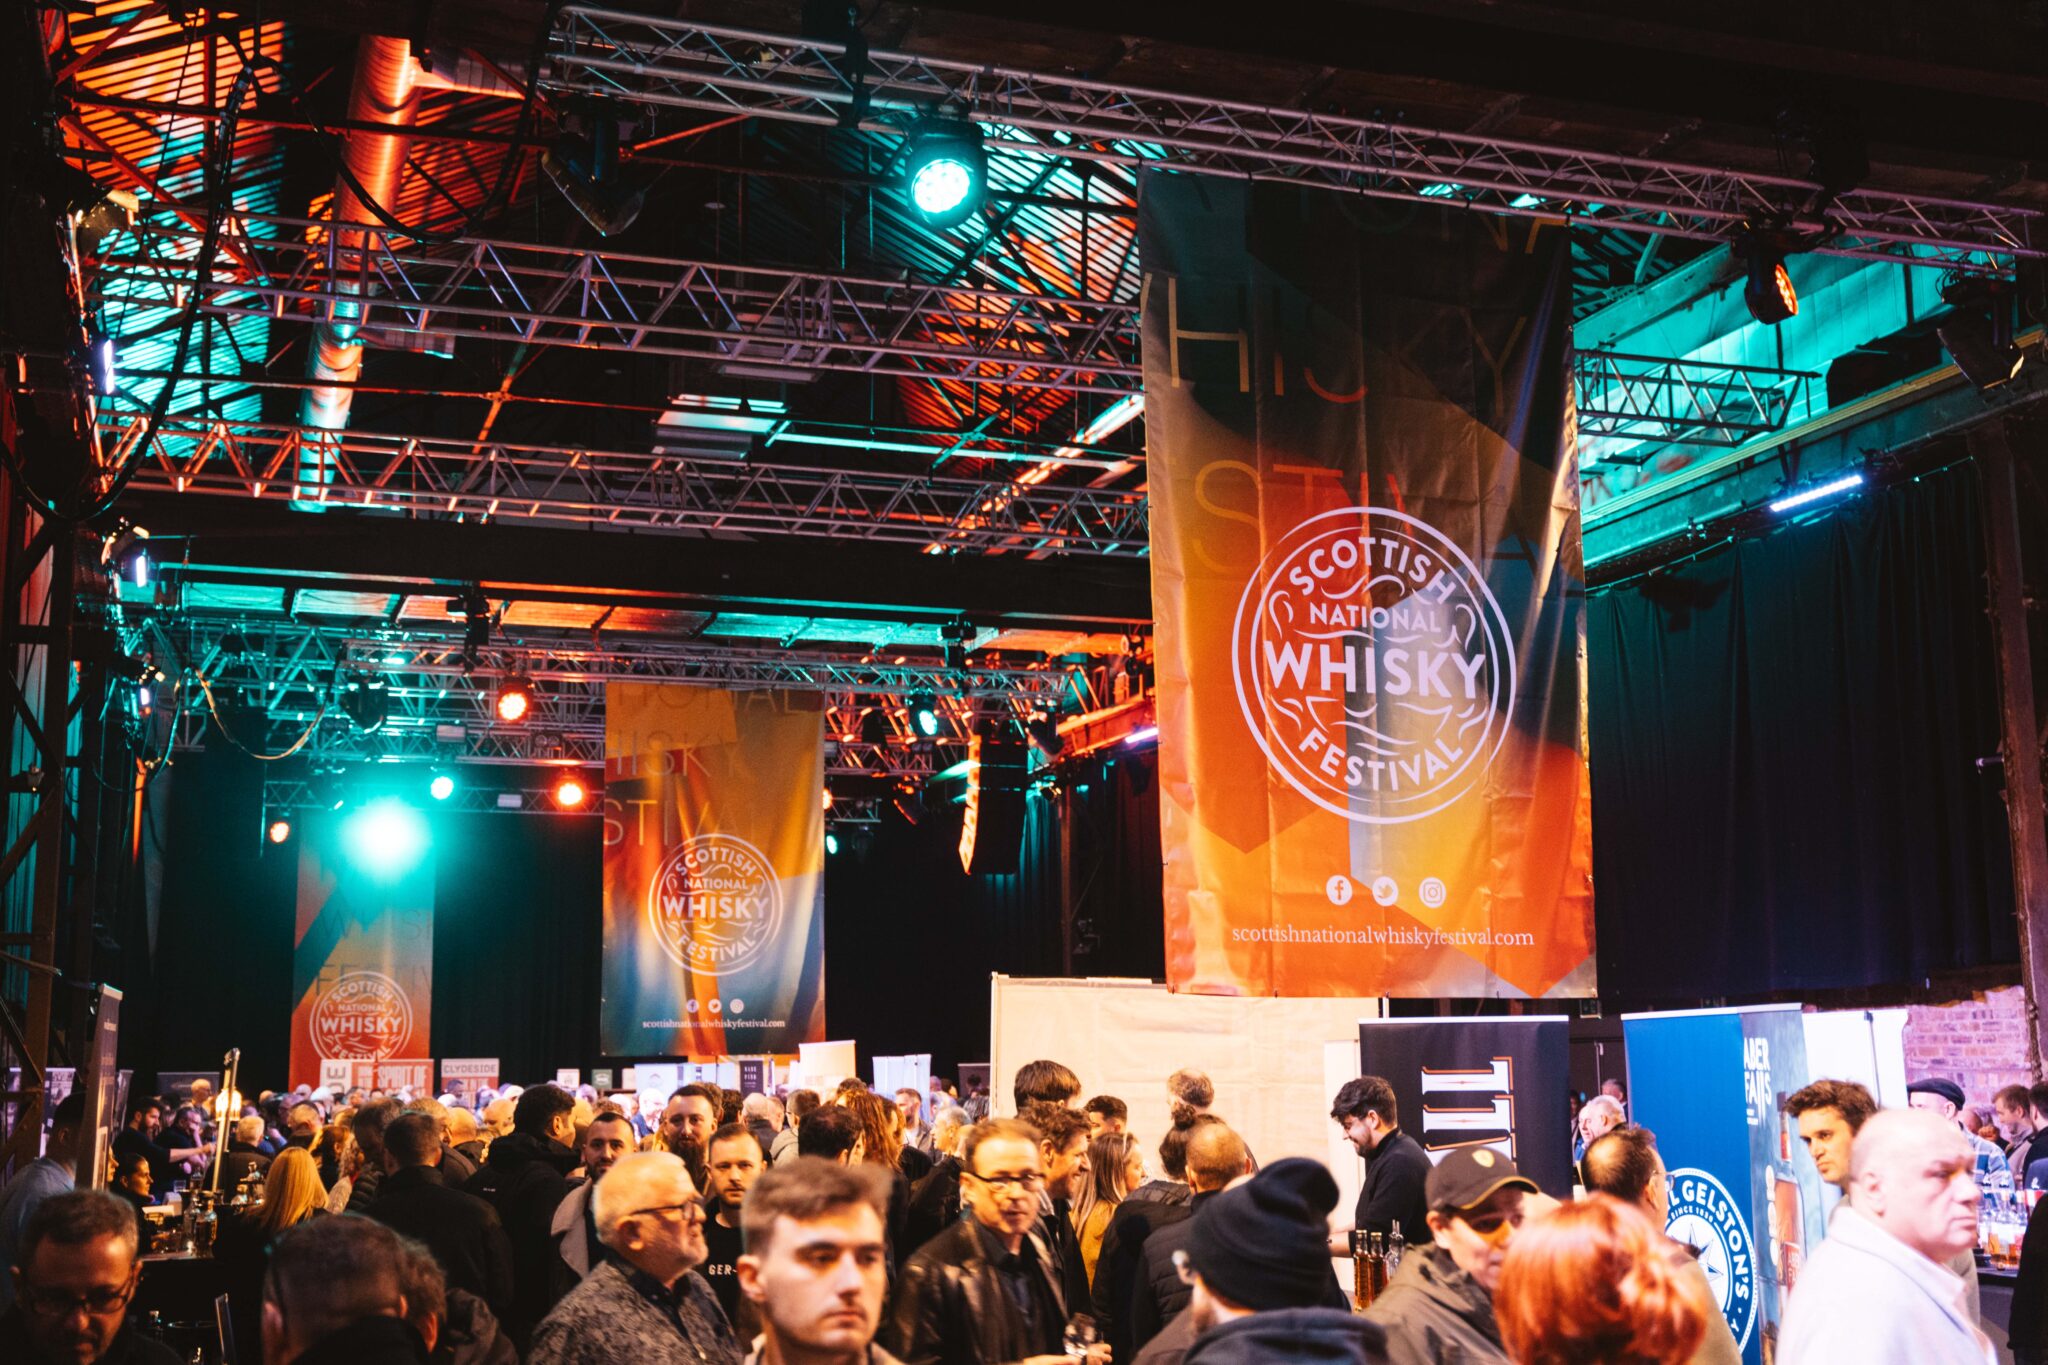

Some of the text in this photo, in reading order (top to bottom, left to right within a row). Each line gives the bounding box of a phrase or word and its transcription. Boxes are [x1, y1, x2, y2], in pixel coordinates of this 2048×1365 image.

[1289, 536, 1457, 606] SCOTTISH
[1309, 602, 1442, 634] NATIONAL
[1263, 640, 1487, 699] WHISKY
[1298, 726, 1464, 792] FESTIVAL
[675, 846, 758, 877] SCOTTISH
[684, 877, 749, 890] NATIONAL
[663, 896, 769, 919] WHISKY
[1232, 923, 1535, 949] scottishnationalwhiskyfestival.com
[677, 935, 757, 962] FESTIVAL
[331, 980, 394, 1003] SCOTTISH
[338, 1003, 387, 1012] NATIONAL
[320, 1016, 402, 1034] WHISKY
[642, 1018, 786, 1031] scottishnationalwhiskyfestival.com
[443, 1064, 497, 1074] CLYDESIDE
[1671, 1205, 1694, 1220] SINCE
[1682, 1180, 1750, 1300] GELSTON'S
